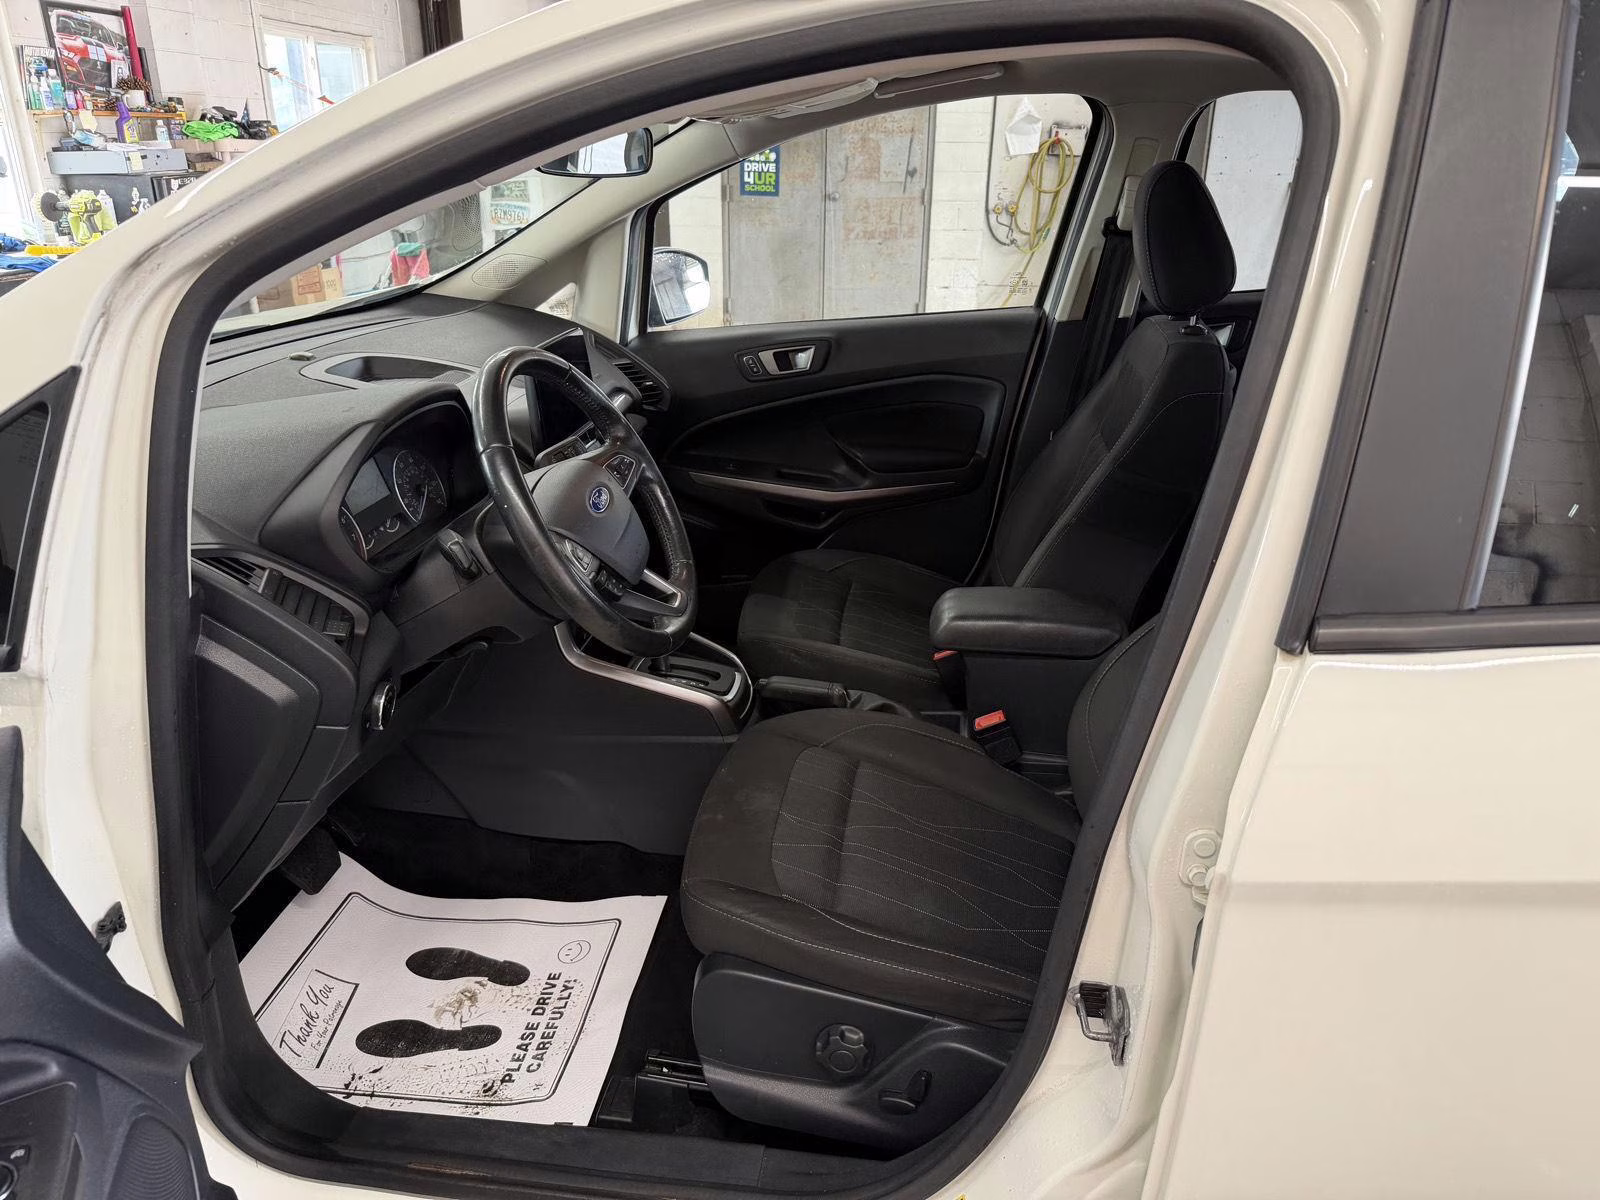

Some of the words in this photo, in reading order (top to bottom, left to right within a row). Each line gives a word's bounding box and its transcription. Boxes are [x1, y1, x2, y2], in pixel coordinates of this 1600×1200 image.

[744, 162, 776, 172] DRIVE
[744, 171, 776, 185] 4UR
[744, 184, 776, 192] SCHOOL
[279, 1003, 320, 1058] Thank
[306, 984, 335, 1007] You
[500, 1021, 541, 1083] PLEASE
[530, 972, 562, 1016] DRIVE
[526, 979, 578, 1073] CAREFULLY!
